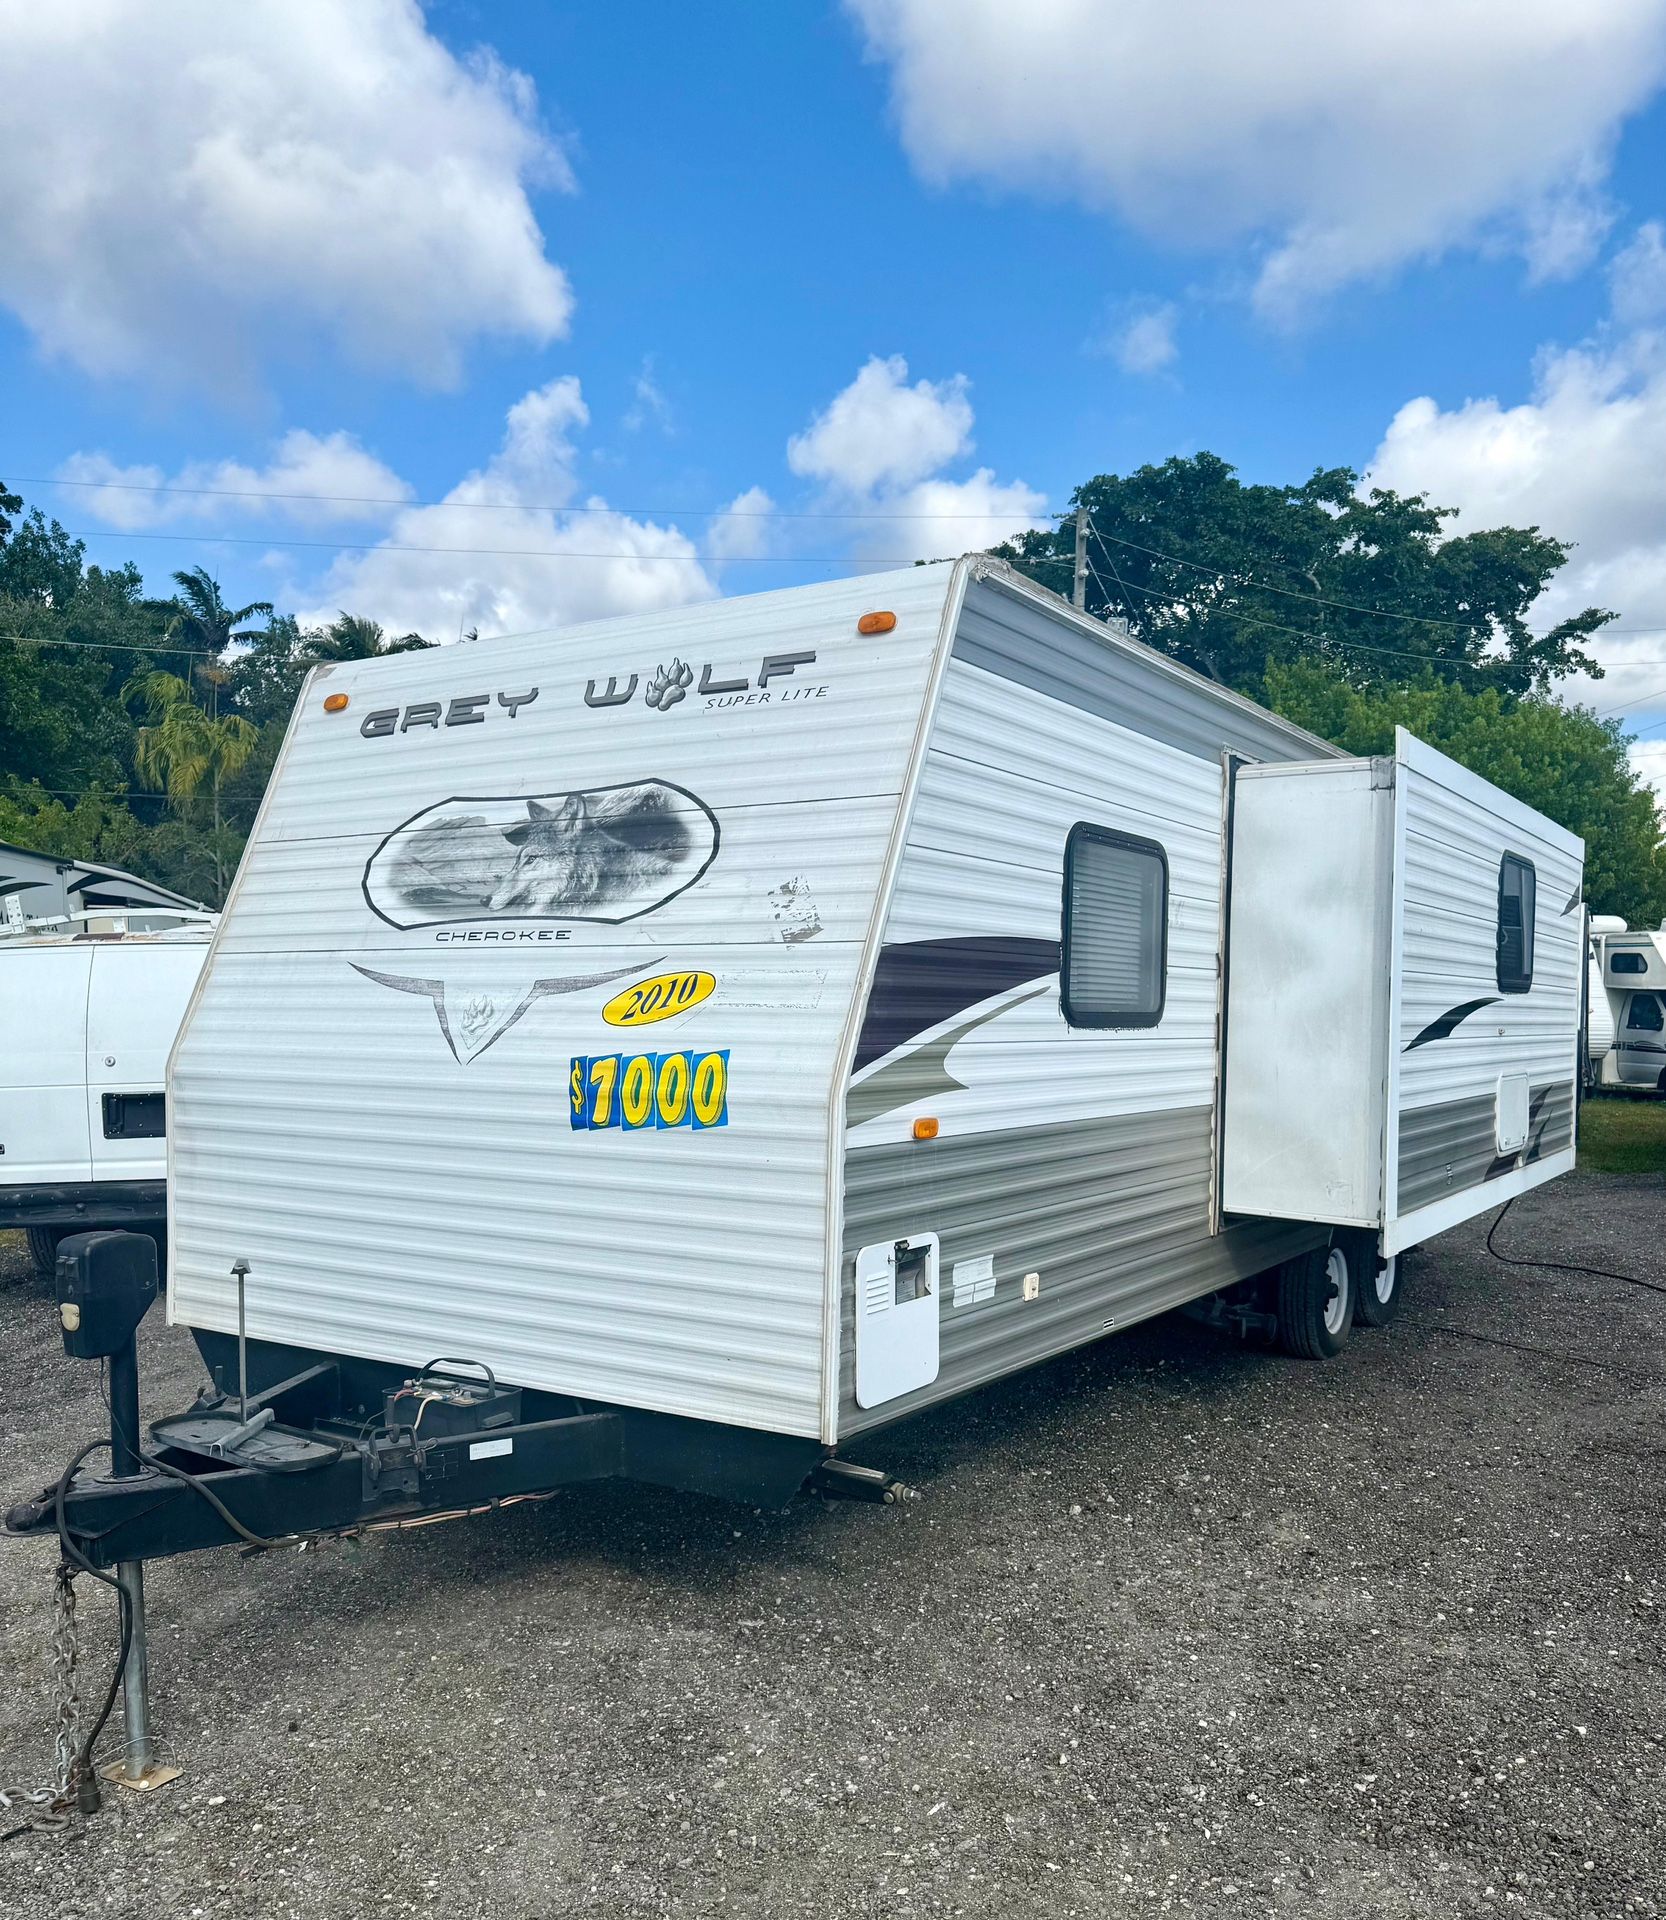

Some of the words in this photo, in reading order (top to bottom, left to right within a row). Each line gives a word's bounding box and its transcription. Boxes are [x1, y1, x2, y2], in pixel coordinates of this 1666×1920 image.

[360, 687, 539, 738] GREY
[584, 650, 816, 711] WLF
[705, 693, 770, 710] SUPER
[781, 685, 829, 702] LITE
[436, 930, 572, 942] CHEROKEE
[620, 973, 699, 1022] 2010
